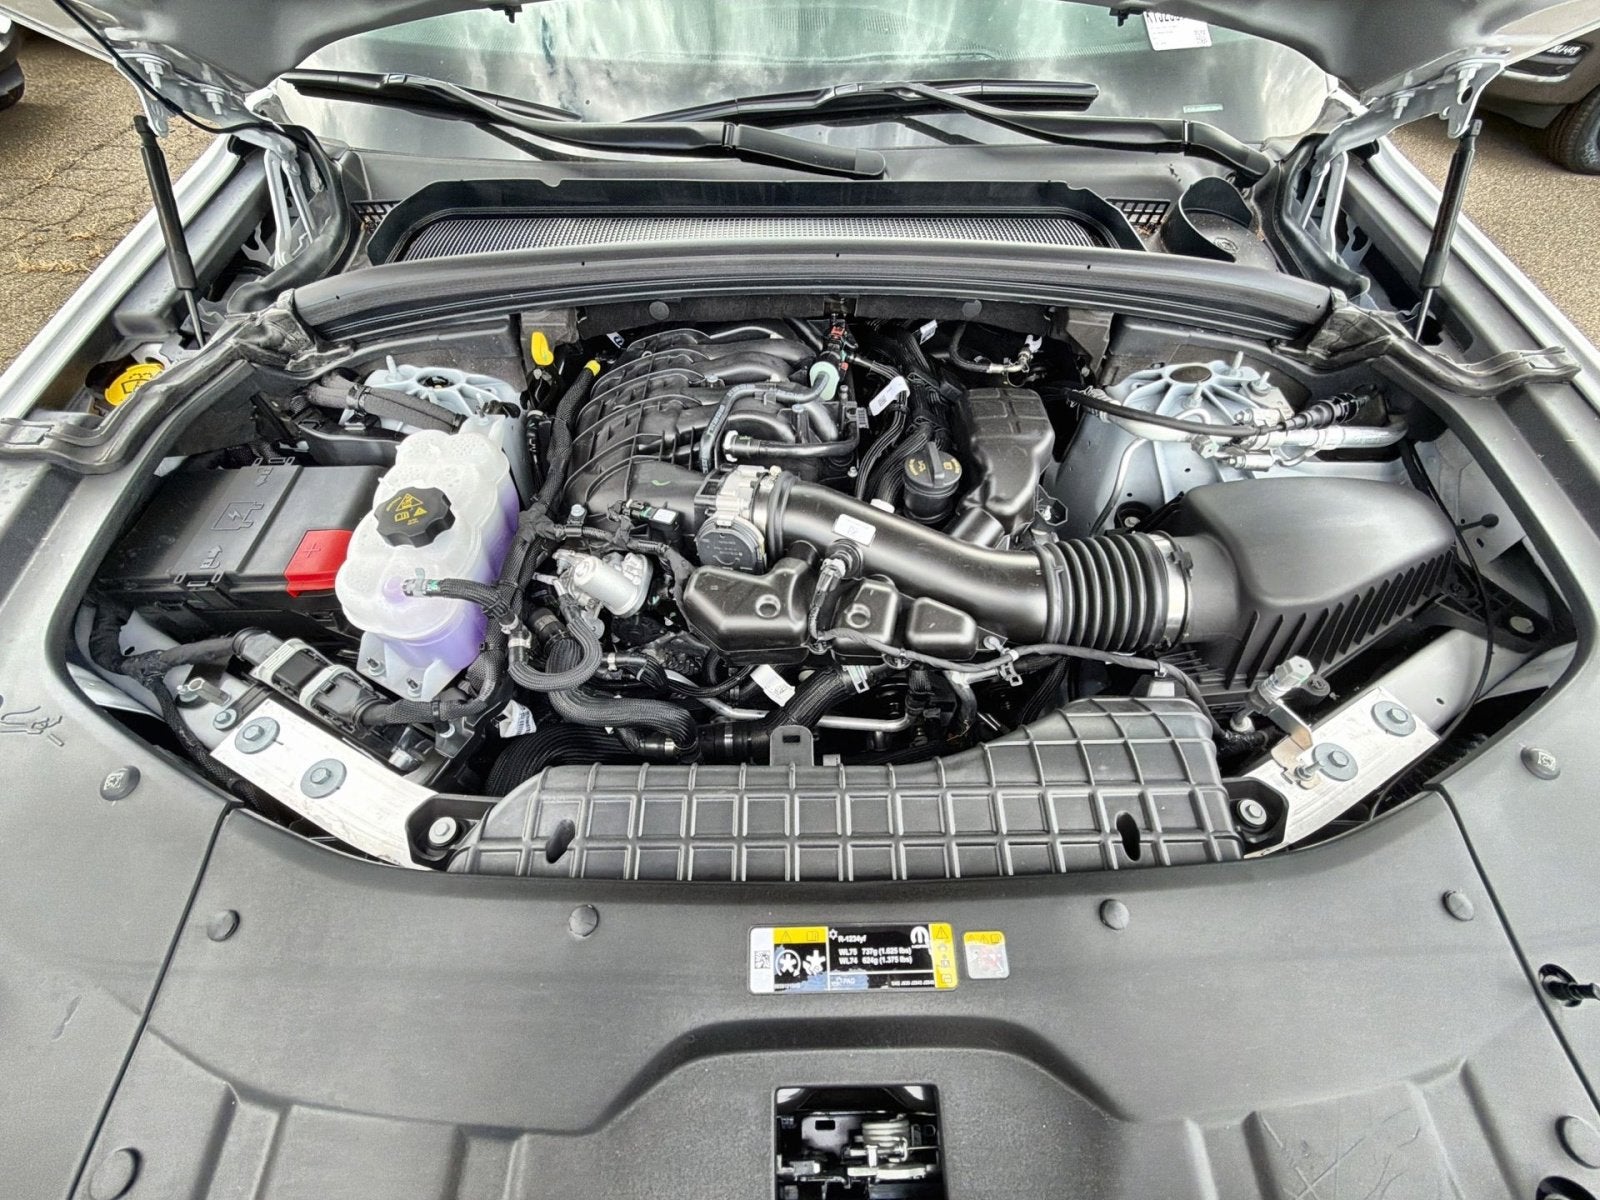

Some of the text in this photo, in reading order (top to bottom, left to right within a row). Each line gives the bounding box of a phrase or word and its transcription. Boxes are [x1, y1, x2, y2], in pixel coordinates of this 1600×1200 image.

[838, 935, 867, 943] R-1234yf
[838, 948, 858, 956] WL75
[861, 948, 878, 956] 737g
[899, 946, 912, 956] lbs)
[839, 955, 913, 966] WL74 624g (1.375 lbs)
